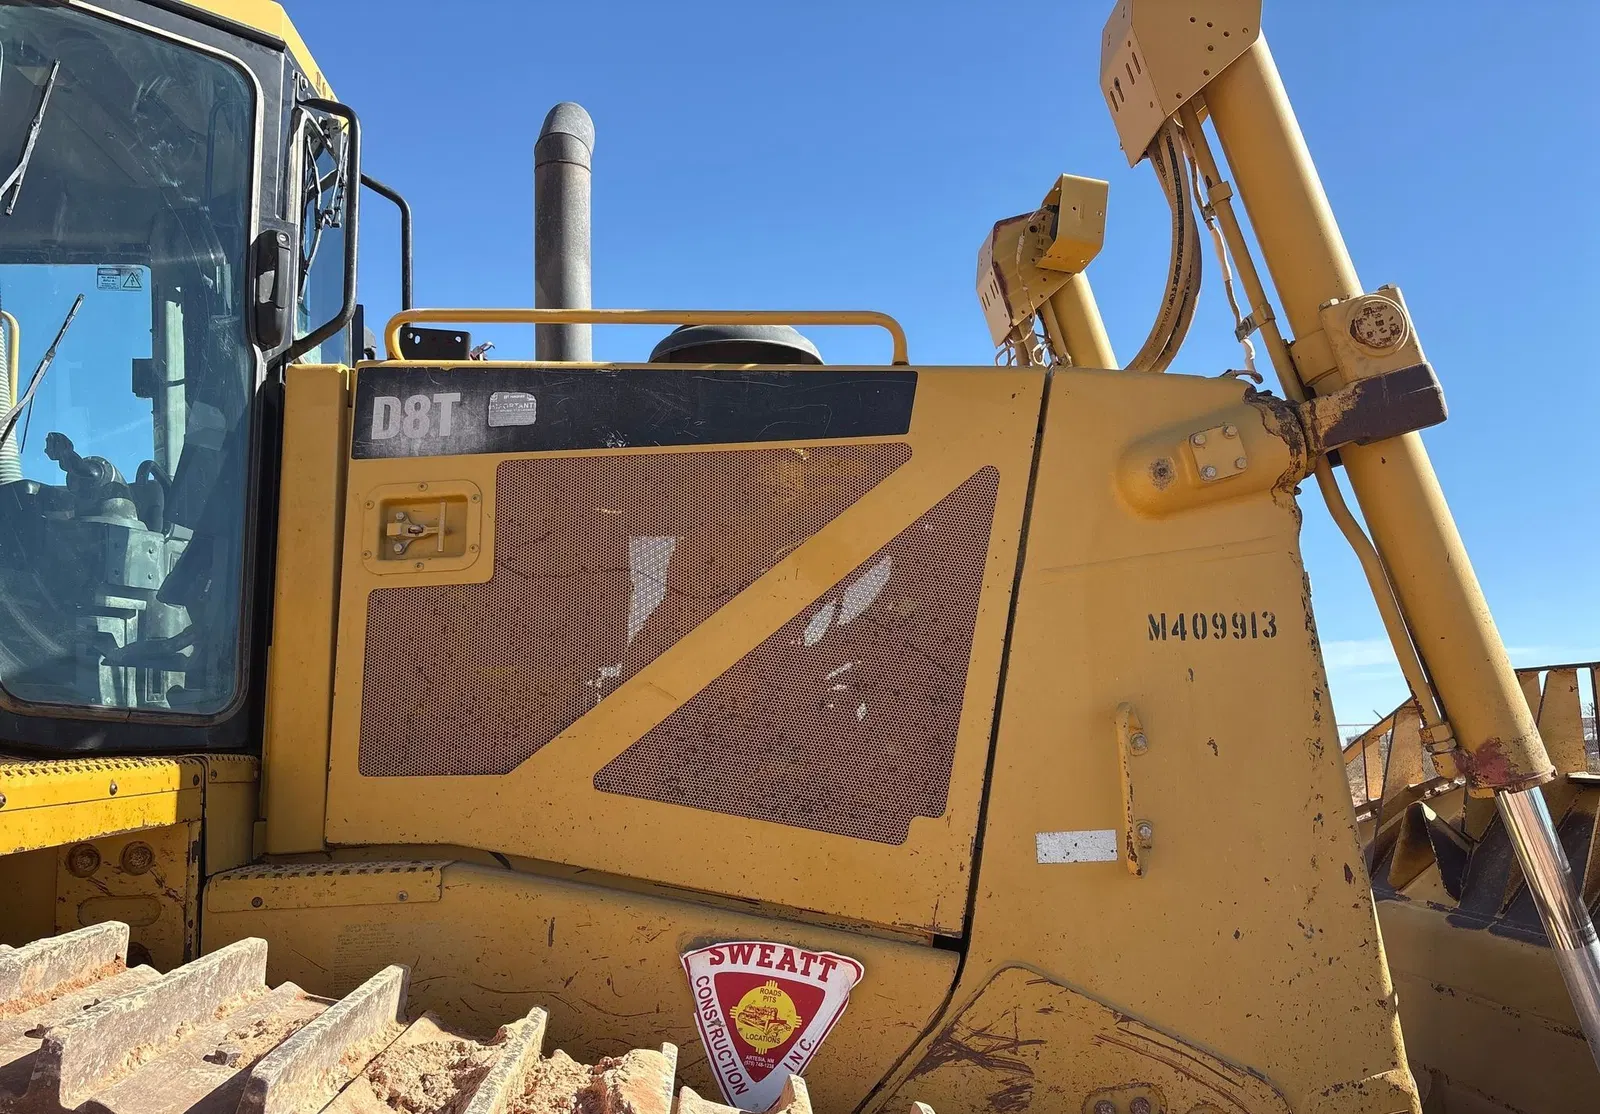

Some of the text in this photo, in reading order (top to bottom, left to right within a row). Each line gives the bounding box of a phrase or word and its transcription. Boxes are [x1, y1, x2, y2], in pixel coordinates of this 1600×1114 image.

[371, 392, 461, 440] D8T
[1147, 611, 1278, 641] M409913
[709, 943, 838, 982] SWEATT
[759, 987, 782, 997] ROADS
[762, 995, 777, 1004] PITS
[695, 975, 750, 1096] CONSTRUCTION
[745, 1032, 781, 1045] LOCATIONS
